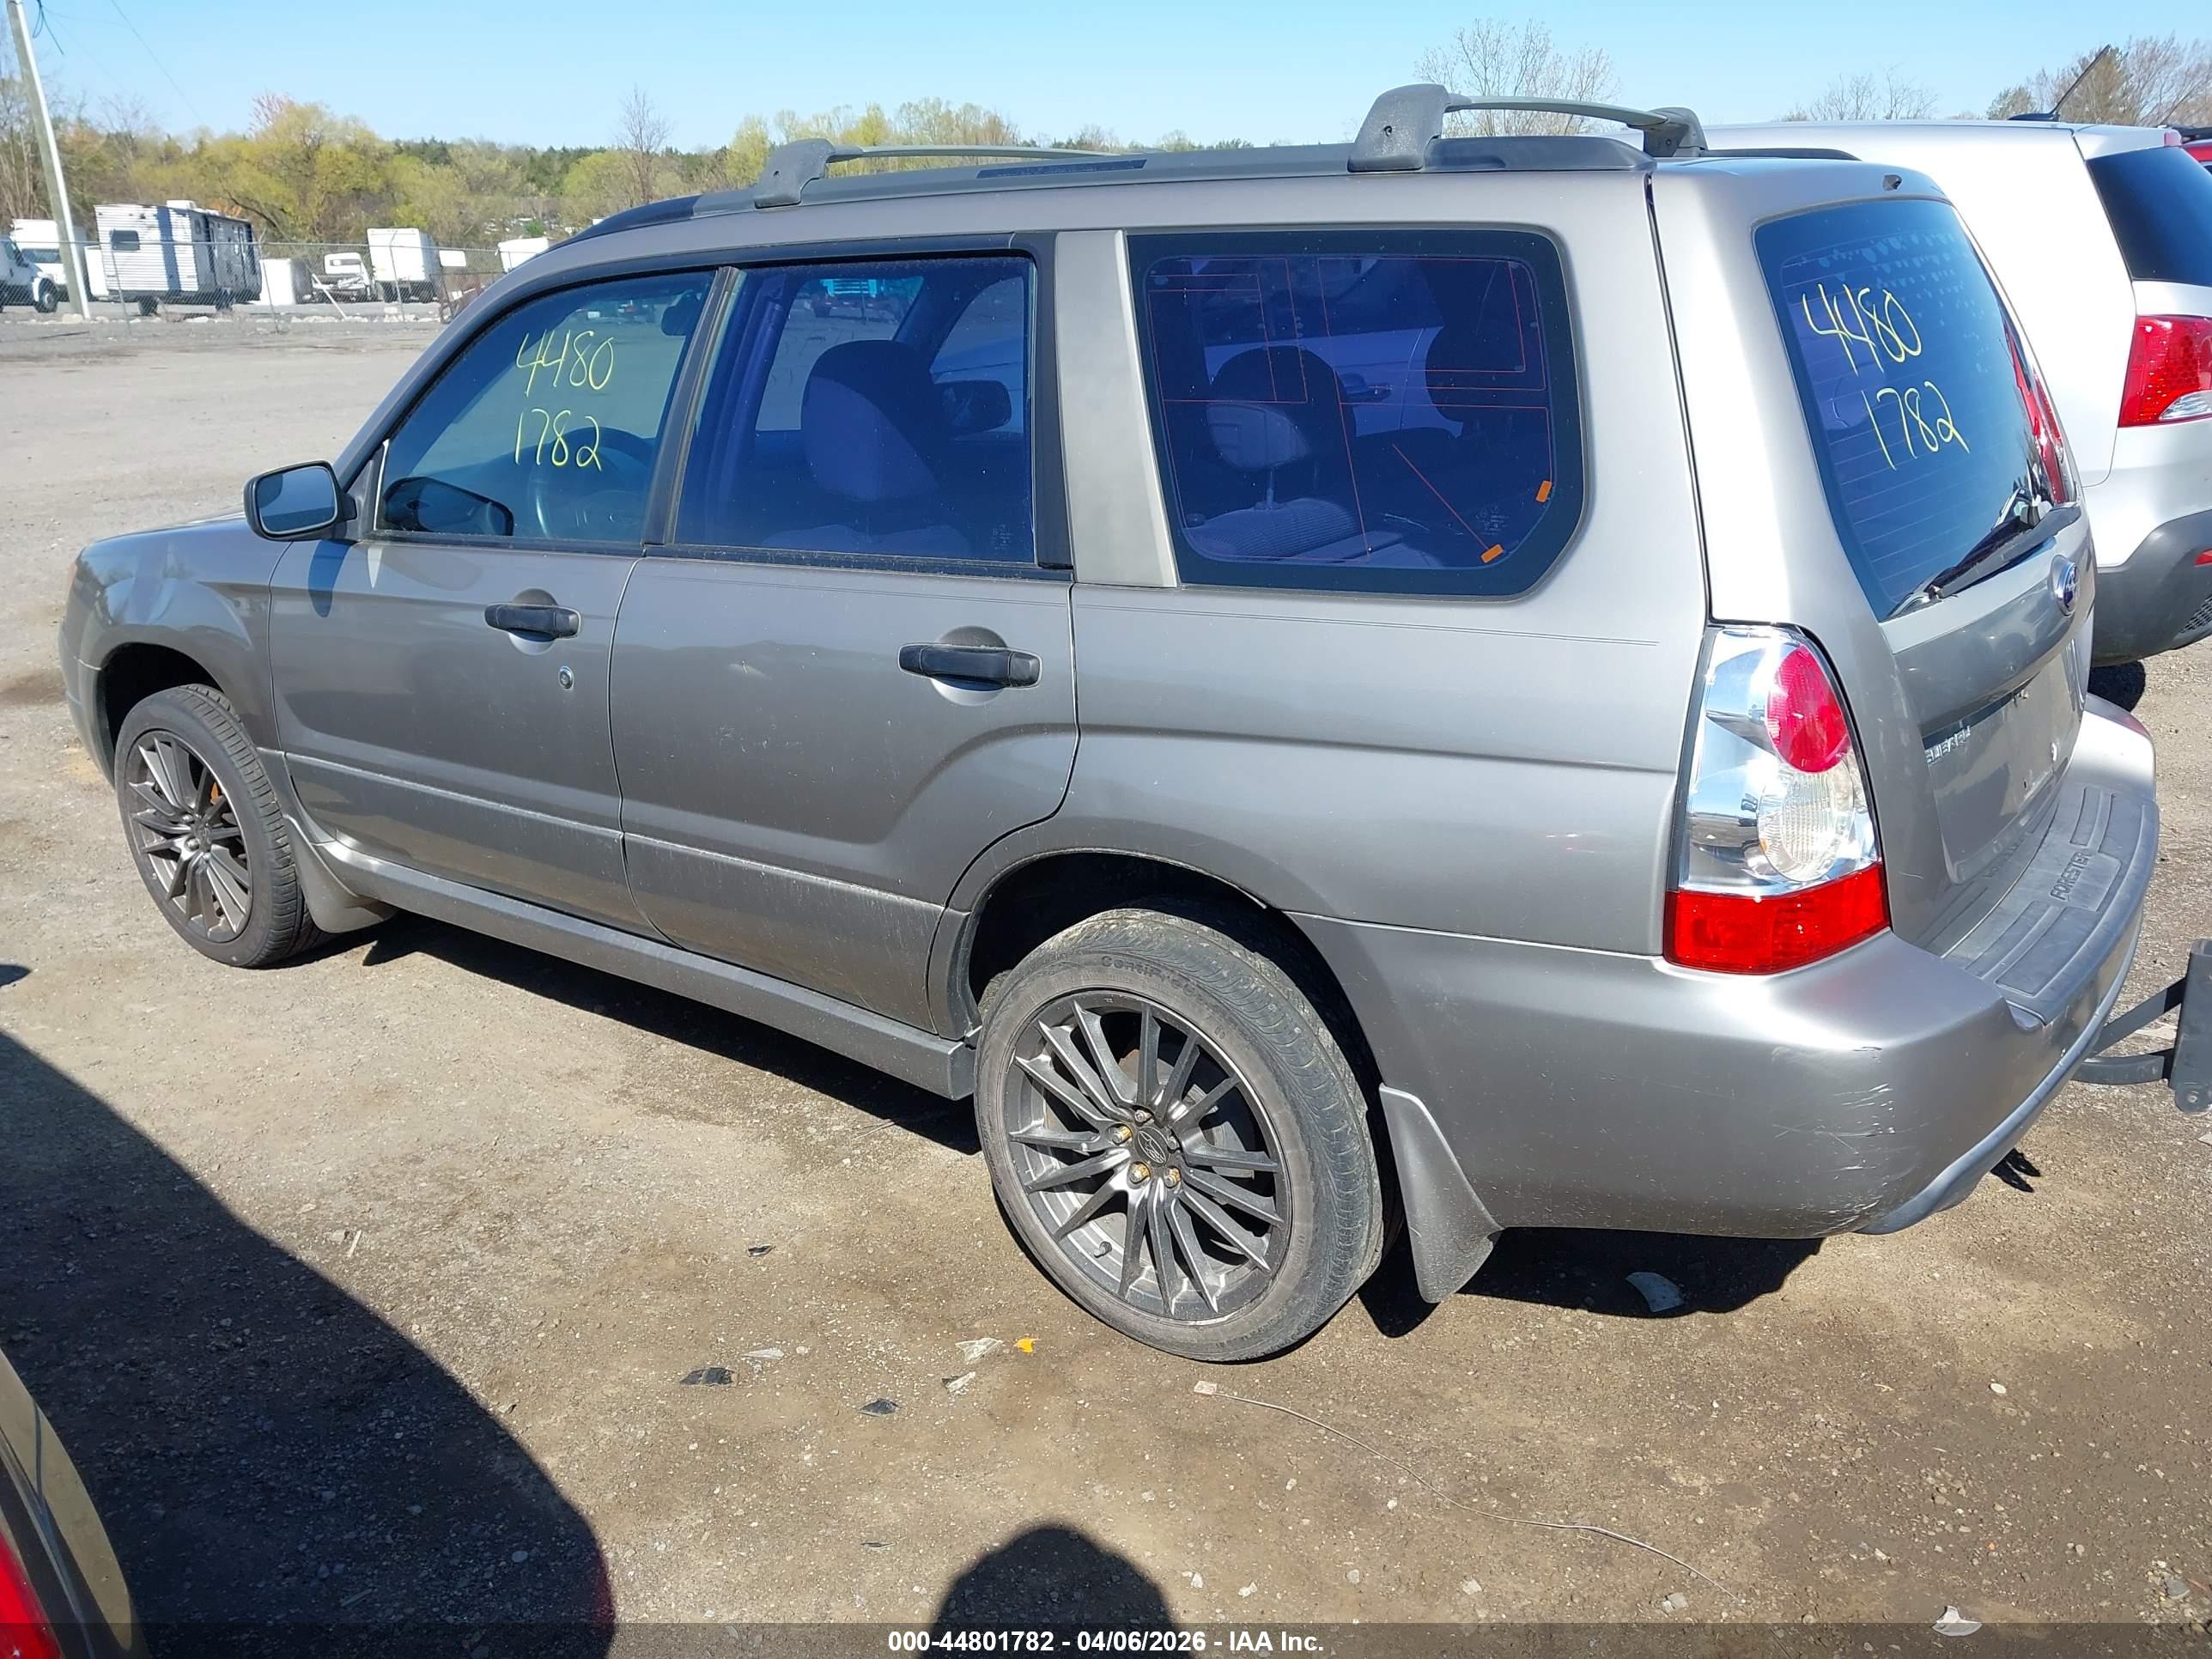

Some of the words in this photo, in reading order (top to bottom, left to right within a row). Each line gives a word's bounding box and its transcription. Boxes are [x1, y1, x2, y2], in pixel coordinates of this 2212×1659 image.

[516, 329, 614, 398] 4480
[1802, 283, 1923, 376] 4480
[514, 408, 602, 472] 1782
[1860, 380, 1971, 471] 1782
[2050, 851, 2092, 902] FORESTER
